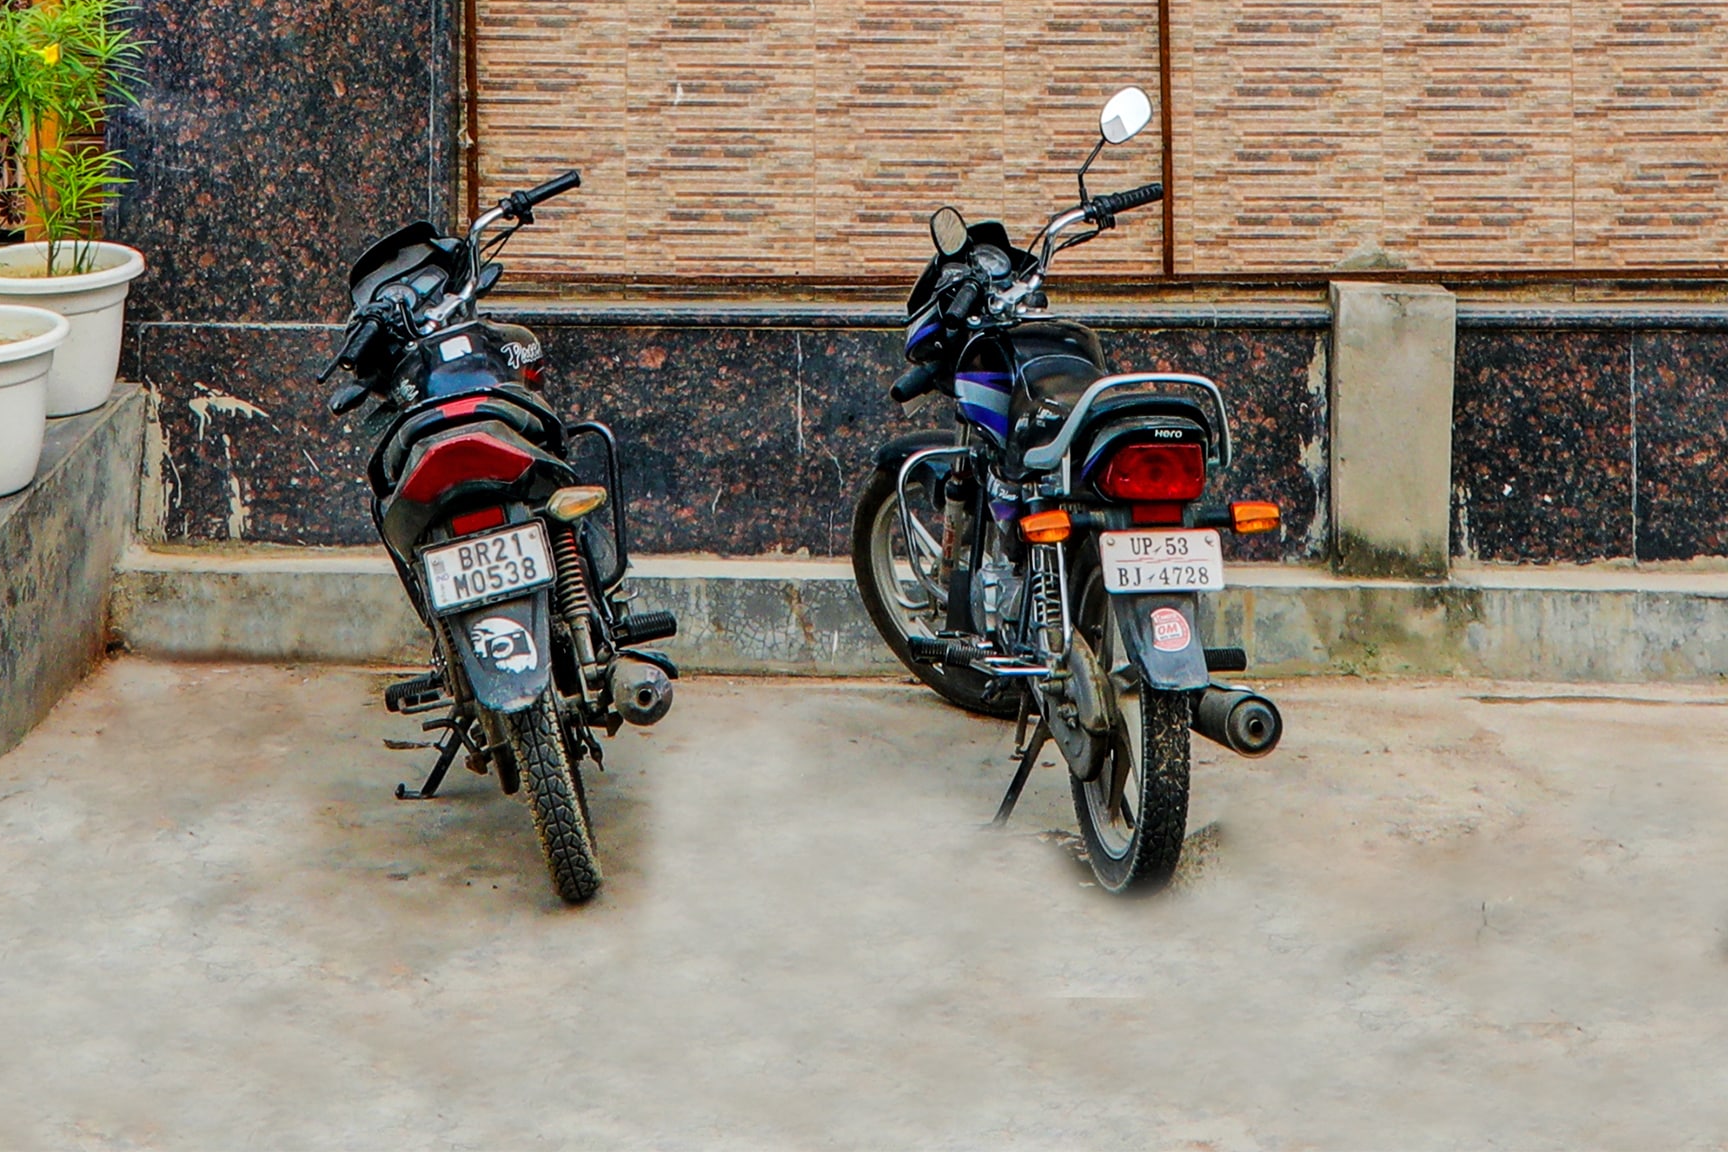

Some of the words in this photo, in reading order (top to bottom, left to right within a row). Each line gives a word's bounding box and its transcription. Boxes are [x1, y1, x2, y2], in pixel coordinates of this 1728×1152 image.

[1154, 428, 1183, 439] Hero
[458, 532, 523, 571] BR21
[454, 556, 537, 600] M0538
